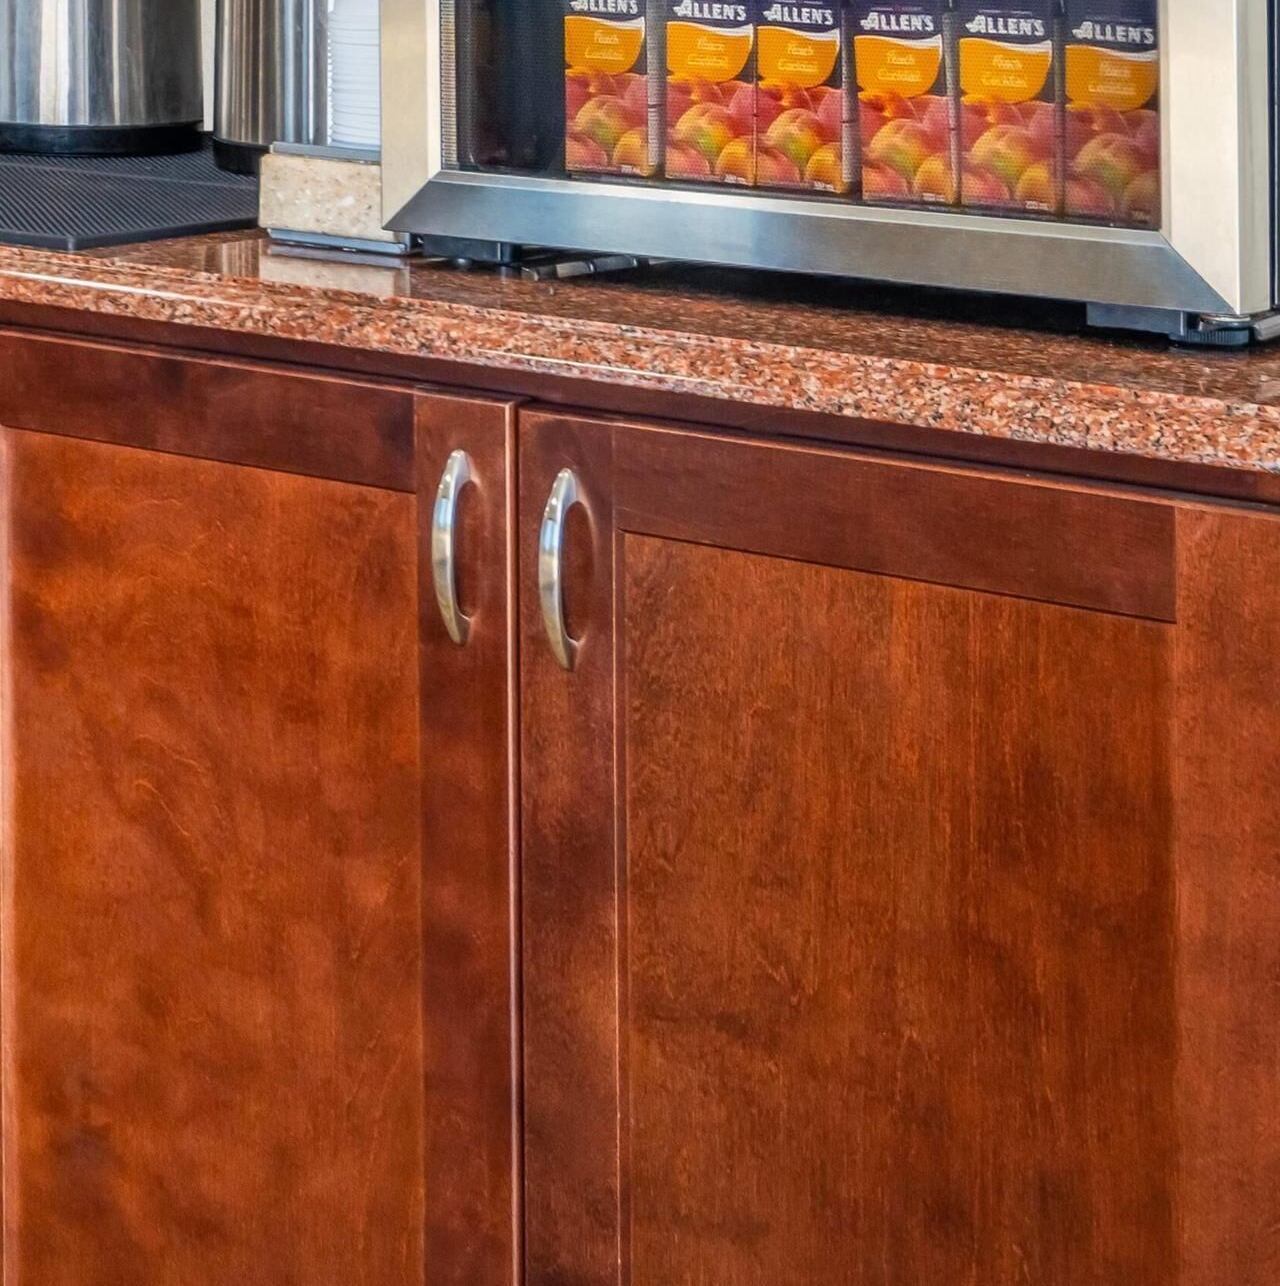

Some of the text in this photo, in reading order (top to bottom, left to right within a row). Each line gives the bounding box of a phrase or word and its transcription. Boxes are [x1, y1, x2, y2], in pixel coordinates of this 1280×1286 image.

[672, 0, 747, 22] ALLEN'S
[762, 4, 833, 25] ALLEN'S
[860, 11, 934, 31] ALLEN'S
[965, 15, 1045, 37] ALLEN'S
[1072, 21, 1154, 45] ALLEN'S
